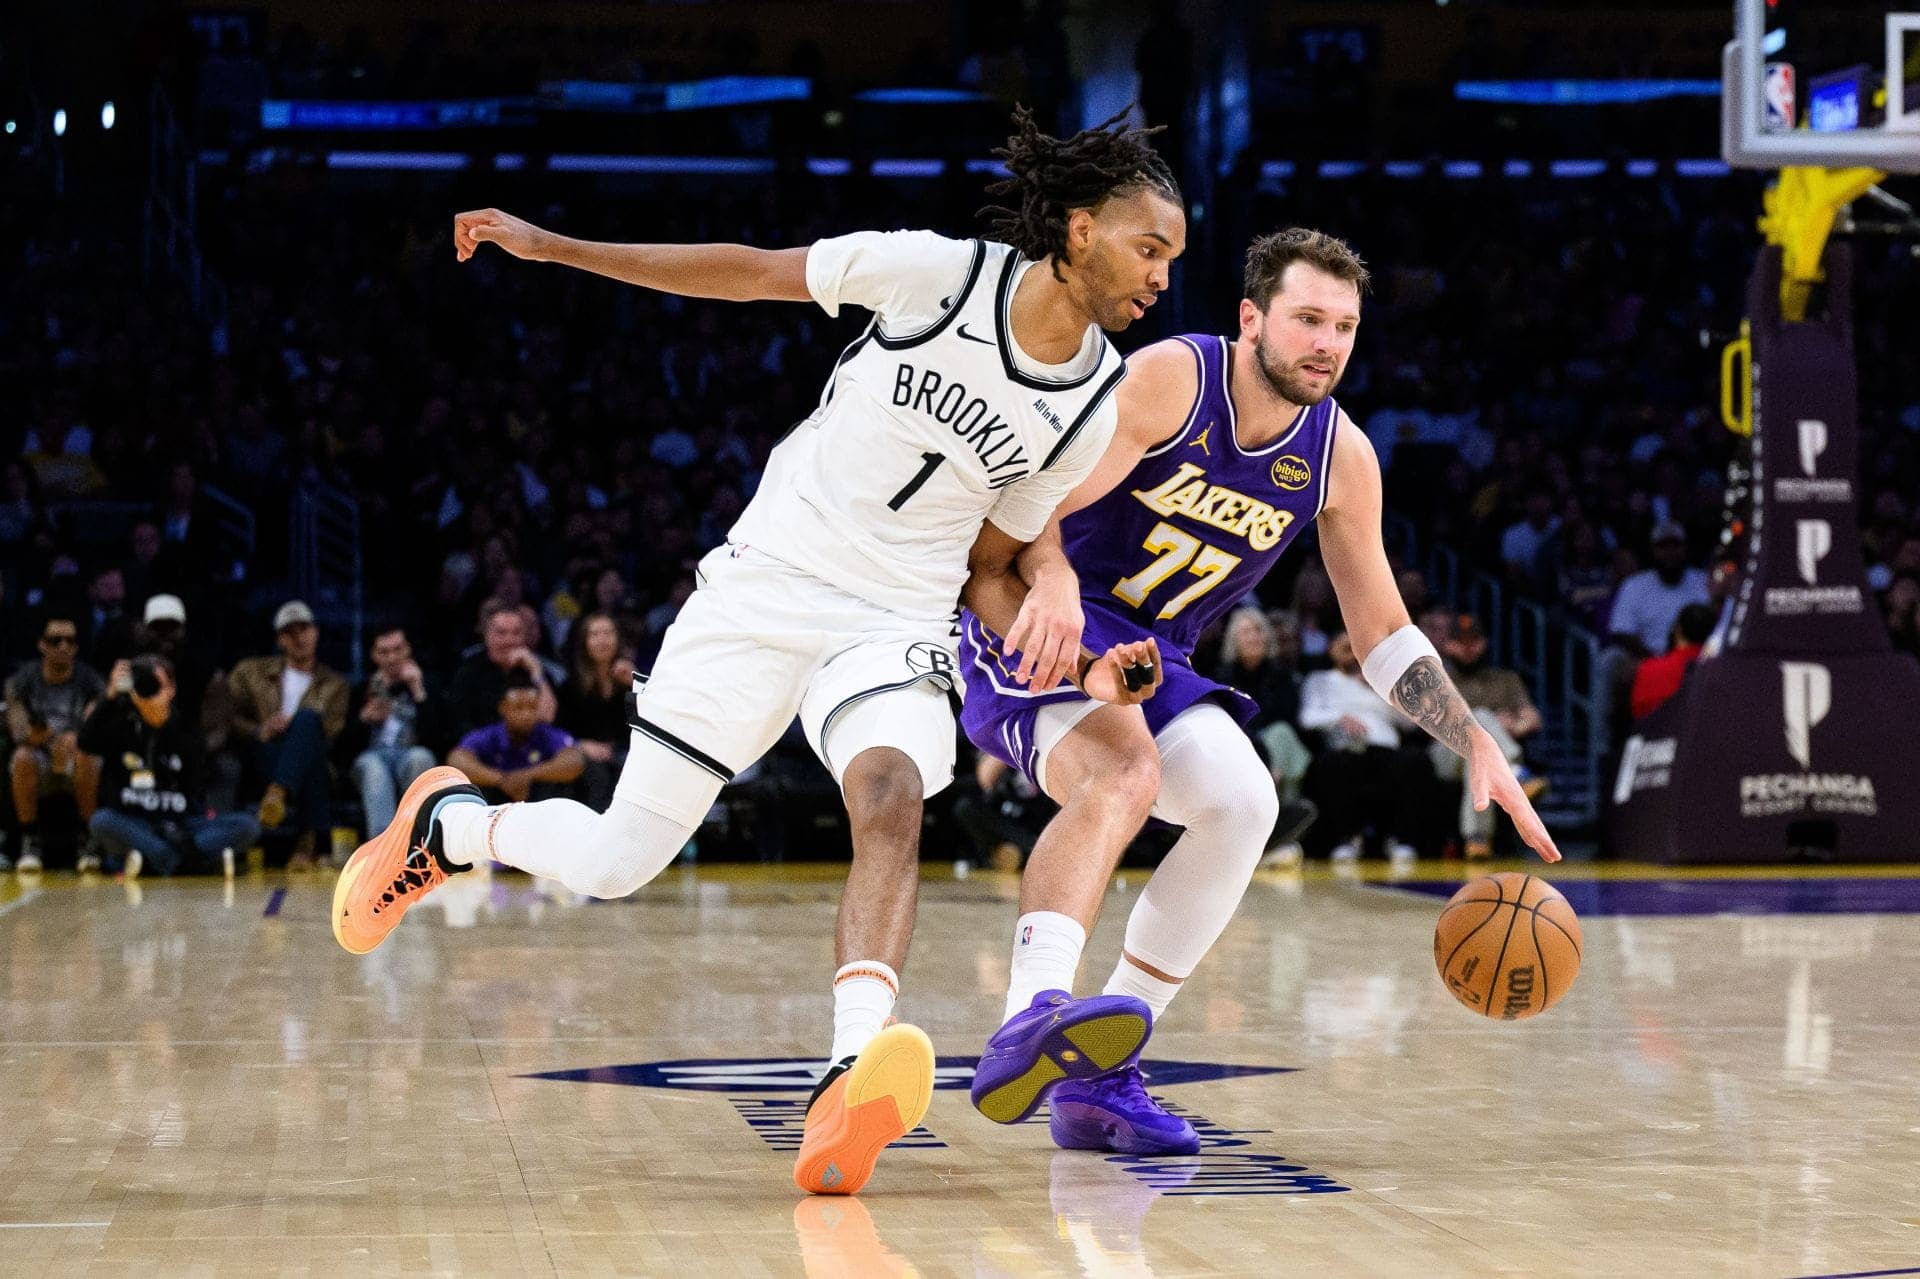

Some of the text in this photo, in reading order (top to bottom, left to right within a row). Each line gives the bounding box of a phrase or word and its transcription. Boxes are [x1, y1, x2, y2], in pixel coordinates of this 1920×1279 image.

[892, 363, 1030, 489] BROOKLYN
[1033, 398, 1064, 434] All In Won
[887, 451, 946, 512] 1
[1130, 461, 1295, 552] LAKERS
[1275, 461, 1309, 482] bibigo
[1111, 521, 1243, 620] 77
